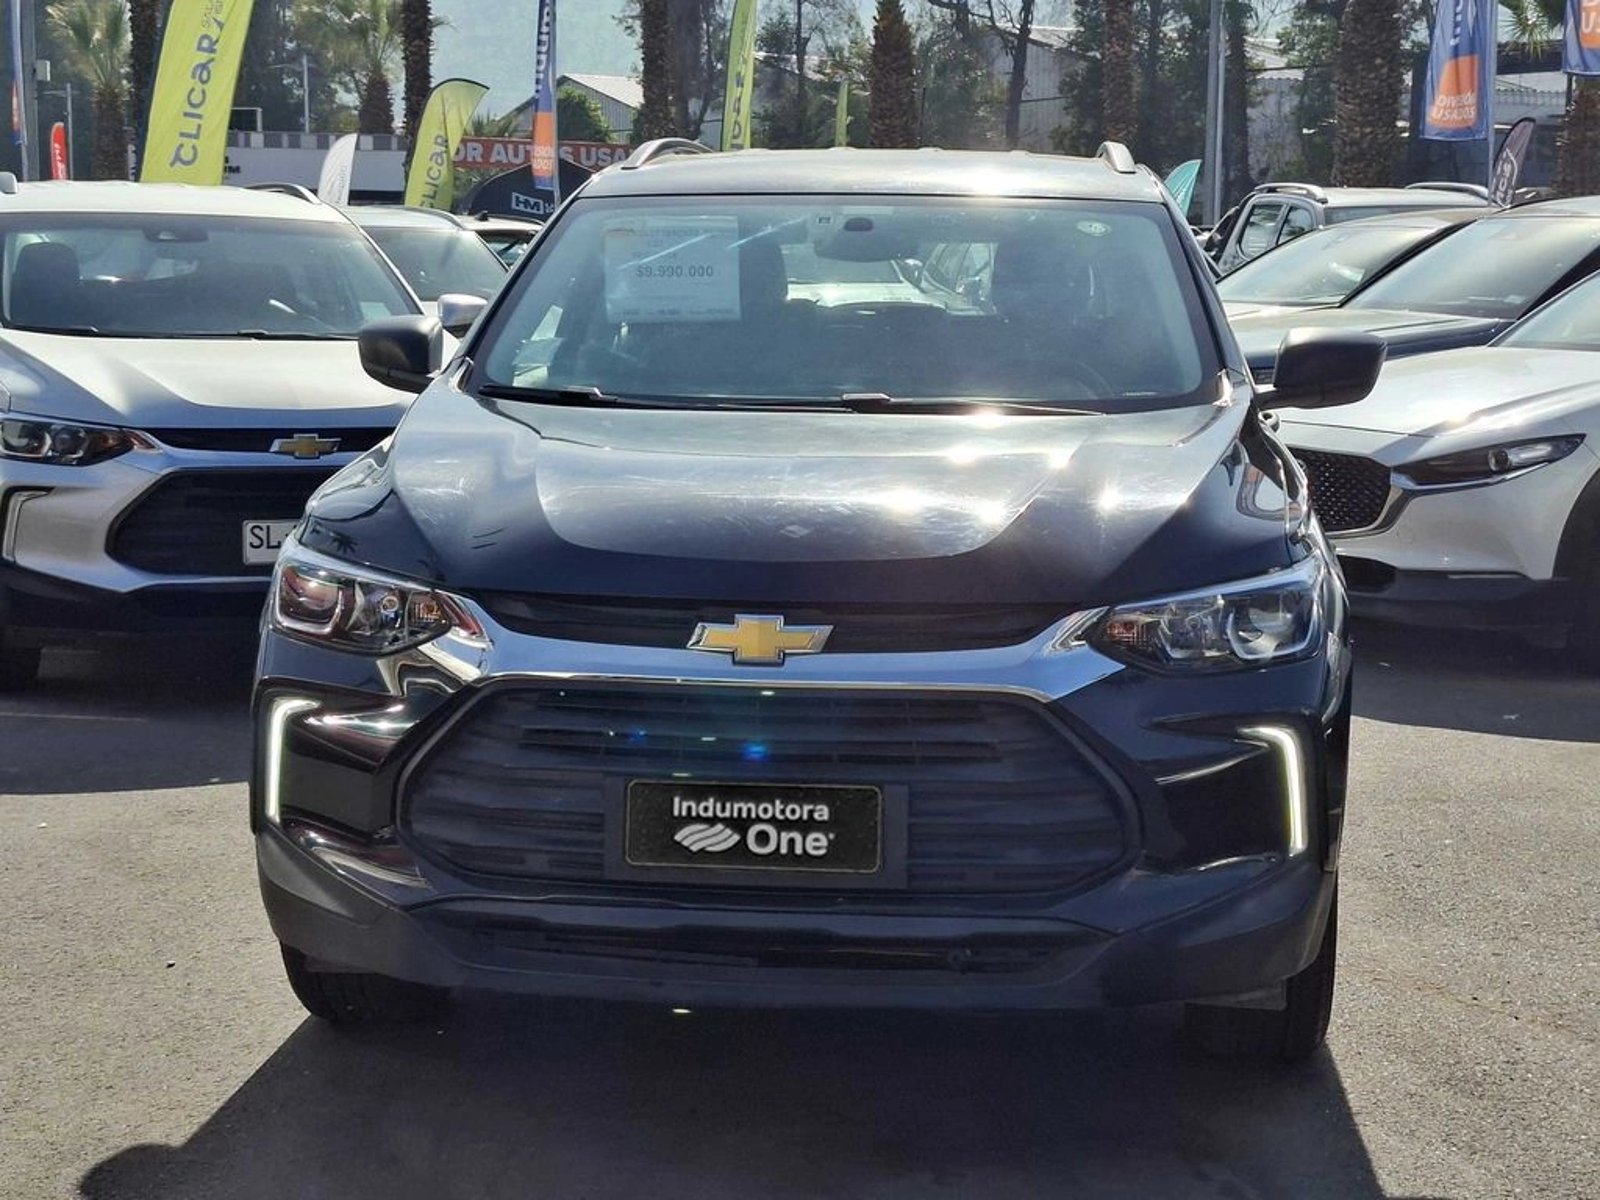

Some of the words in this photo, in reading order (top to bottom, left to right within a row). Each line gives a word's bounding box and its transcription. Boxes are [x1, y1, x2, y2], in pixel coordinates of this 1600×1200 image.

[635, 264, 714, 278] $9.990.000
[672, 796, 830, 821] Indumotora
[746, 823, 829, 856] One
